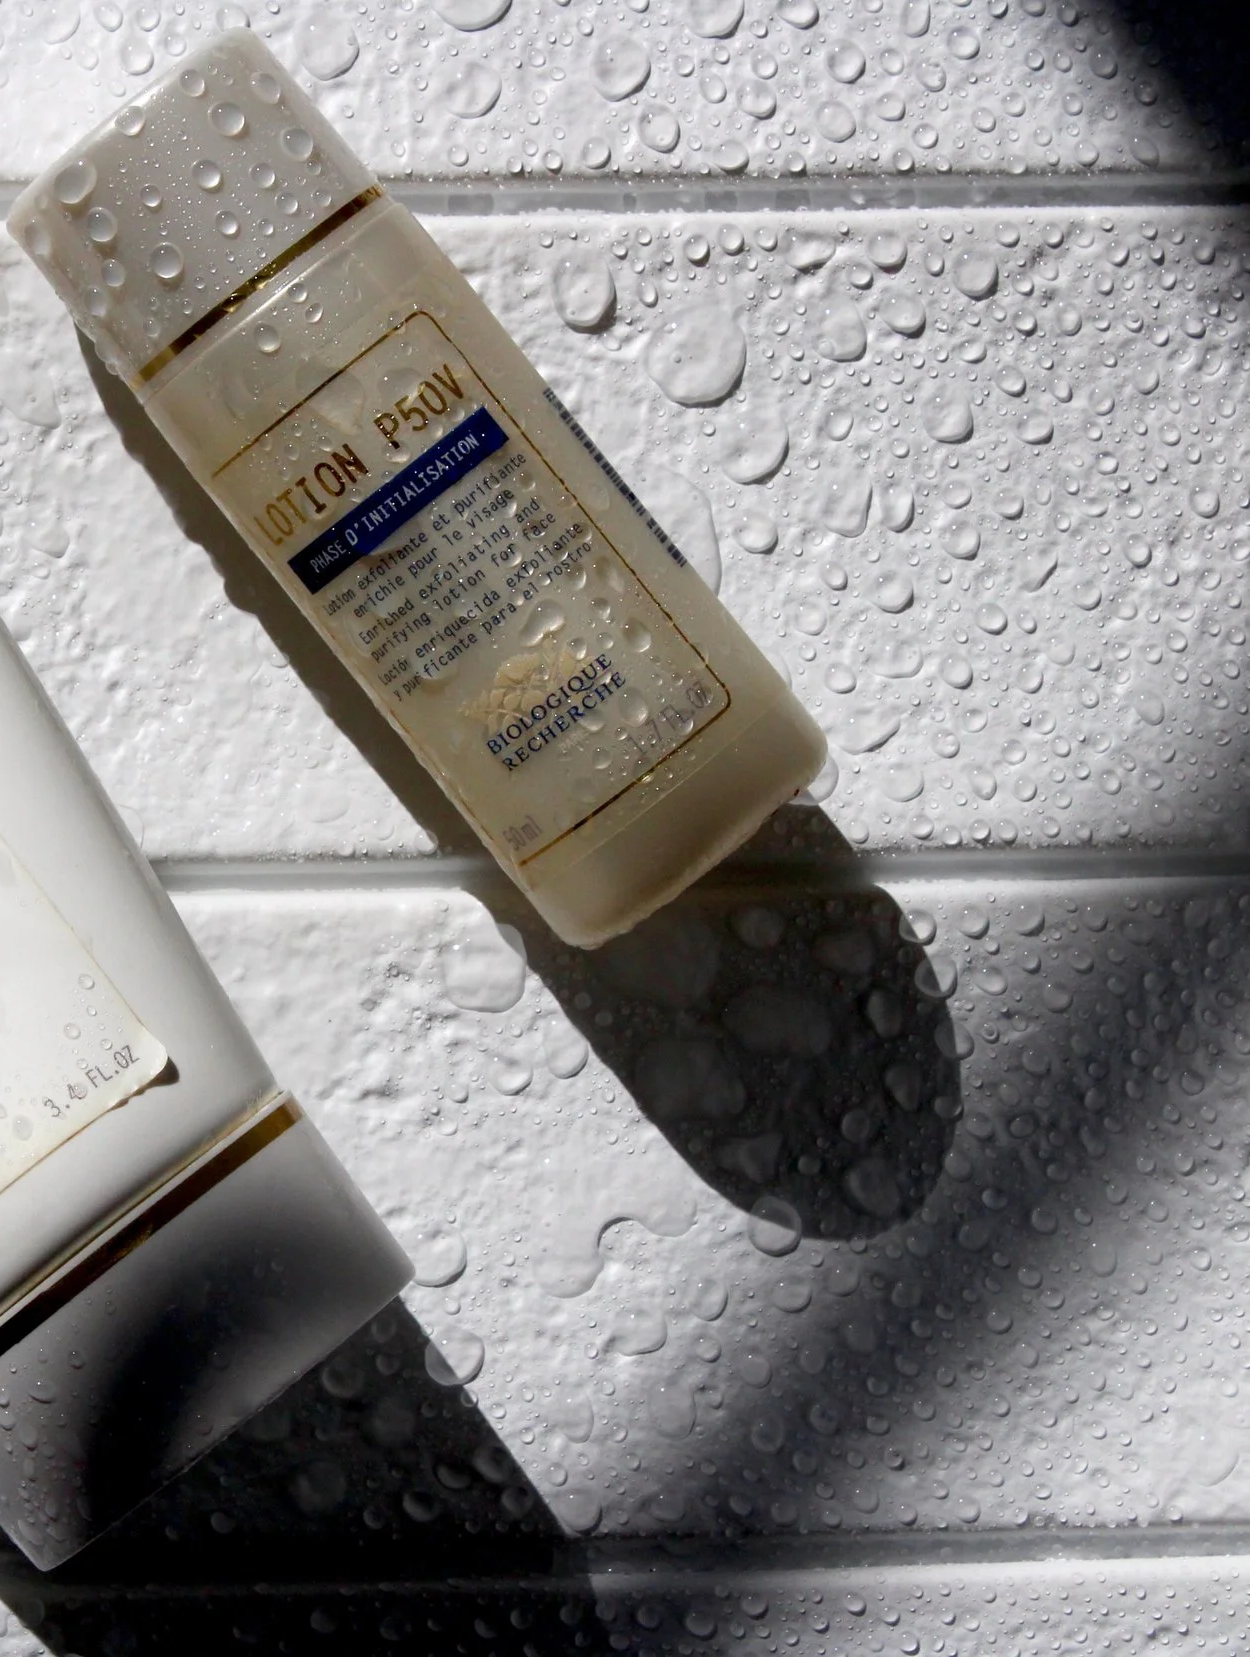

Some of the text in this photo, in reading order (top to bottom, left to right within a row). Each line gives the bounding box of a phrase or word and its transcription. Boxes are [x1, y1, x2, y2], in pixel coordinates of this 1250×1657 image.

[254, 364, 464, 547] LOTION P50V
[309, 434, 480, 574] PHASE D'INITIALISATION
[357, 533, 427, 590] exfoliante
[432, 514, 451, 532] et
[359, 500, 541, 645] Enriched exfoliating and
[371, 512, 556, 663] purifying lotion for face
[412, 548, 439, 579] pour
[442, 526, 463, 548] le
[466, 487, 515, 530] visage
[415, 584, 503, 660] enriquecida
[506, 522, 584, 590] exfoliante
[393, 688, 403, 702] y
[484, 603, 518, 636] para
[521, 580, 541, 603] el
[546, 542, 591, 585] rostro
[486, 654, 614, 755] BIOLOGIQUE
[501, 672, 626, 771] RECHERCHE
[502, 815, 543, 851] 50ml
[85, 1045, 140, 1090] FL.OZ
